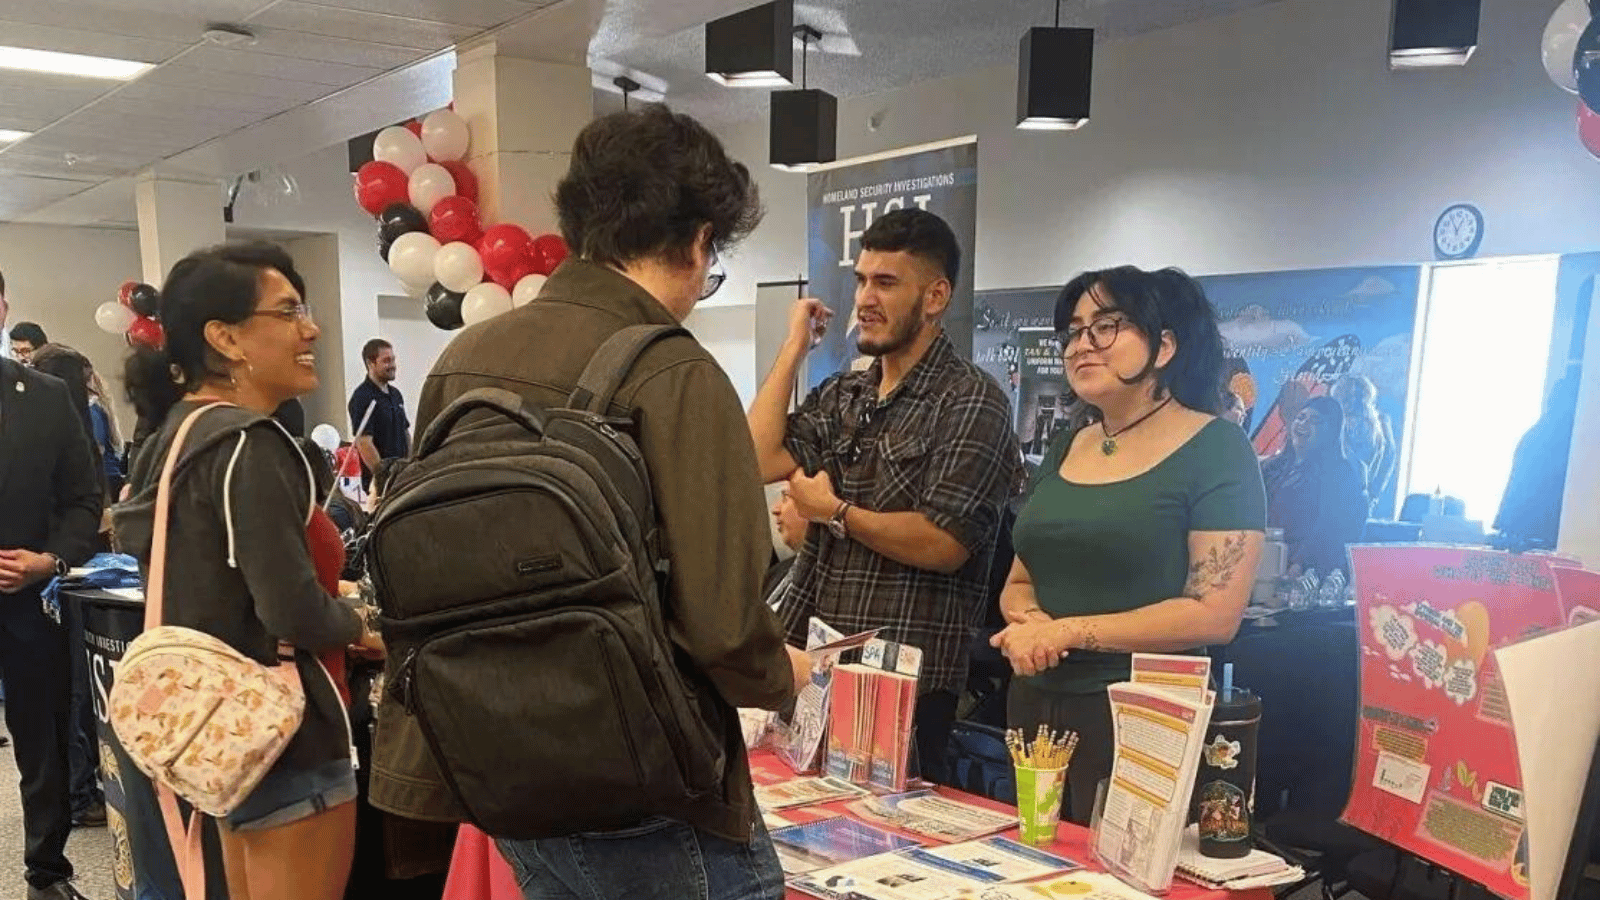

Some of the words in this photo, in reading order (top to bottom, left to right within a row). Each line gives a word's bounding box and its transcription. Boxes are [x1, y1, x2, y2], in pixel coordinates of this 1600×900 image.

[823, 188, 859, 204] HOMELAND
[860, 181, 893, 198] SECURITY
[894, 172, 955, 192] INVESTIGATIONS
